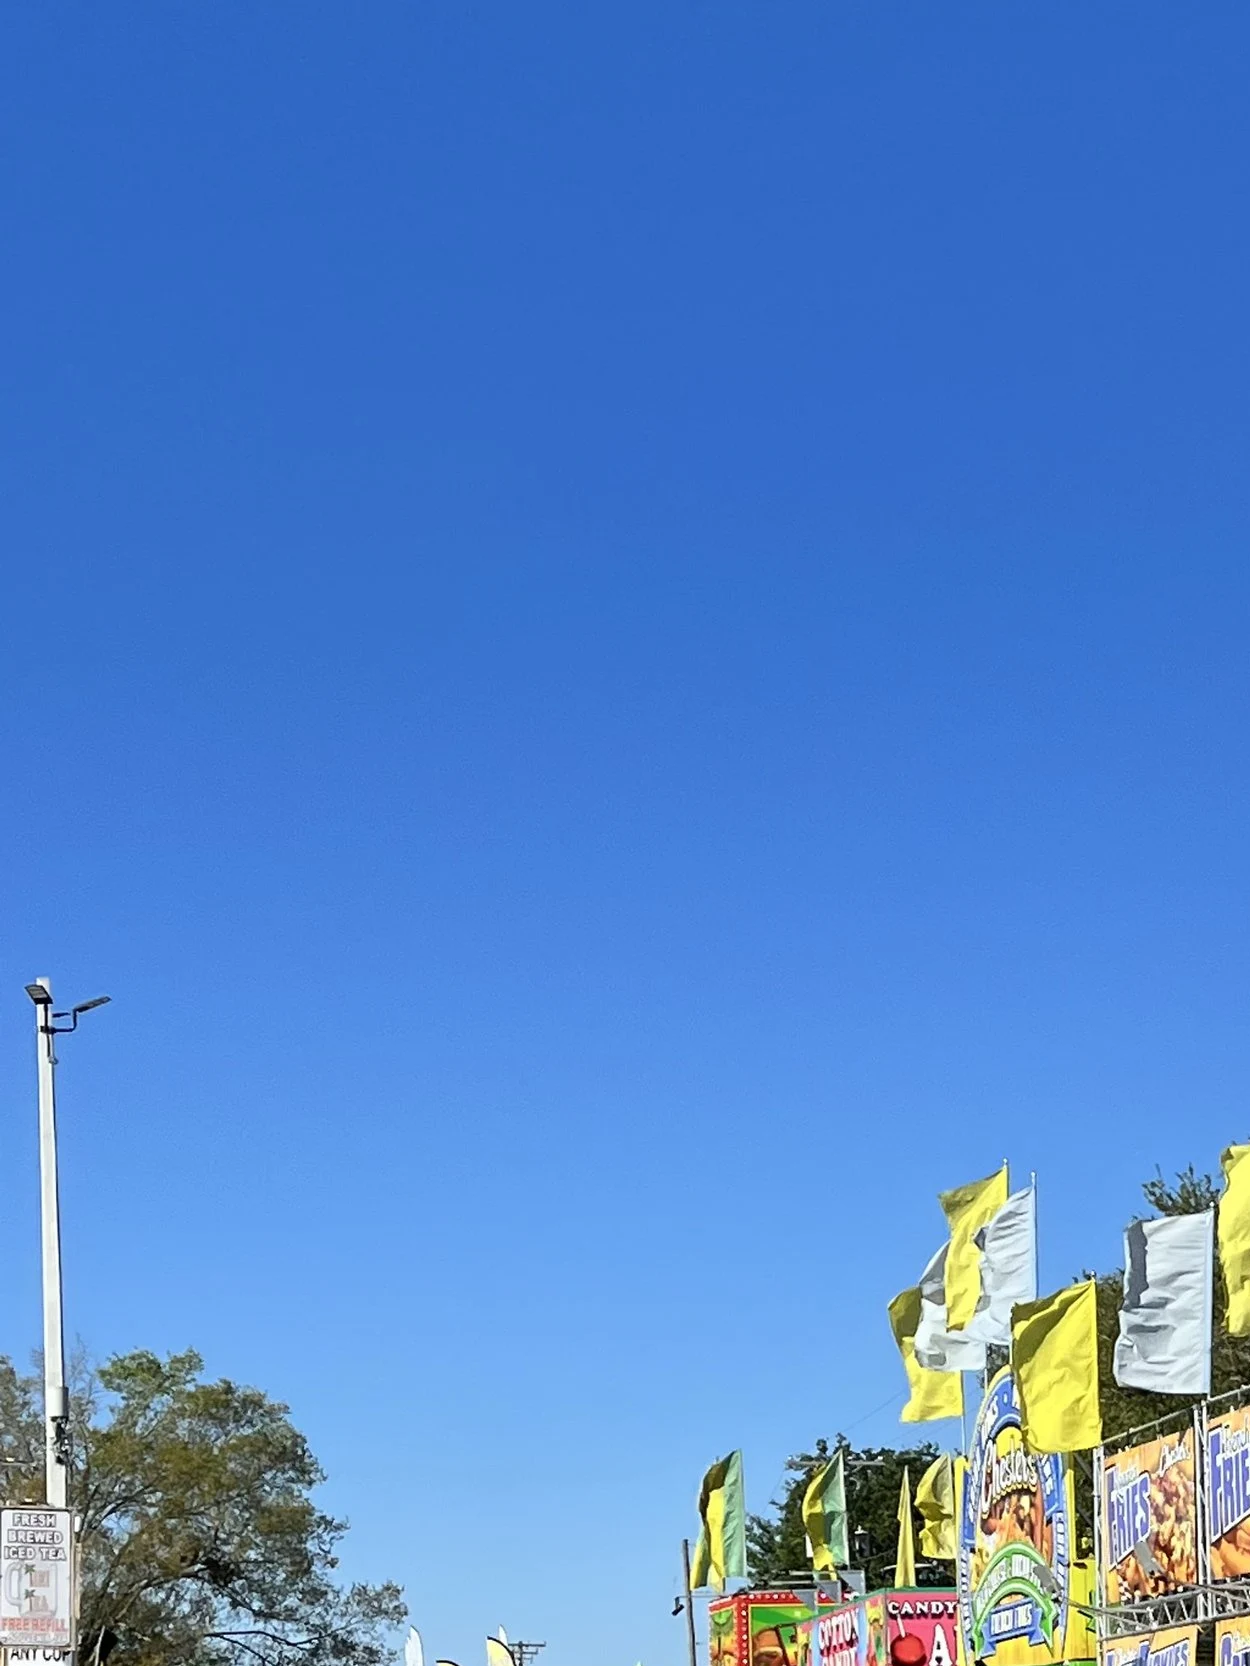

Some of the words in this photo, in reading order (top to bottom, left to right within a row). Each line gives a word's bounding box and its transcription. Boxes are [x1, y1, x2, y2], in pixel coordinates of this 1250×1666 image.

[13, 1513, 56, 1528] FRESH
[1105, 1467, 1151, 1570] FRIES
[7, 1528, 64, 1544] BREWED
[4, 1546, 36, 1560] ICED
[40, 1546, 67, 1562] TEA
[887, 1600, 957, 1619] CANDY
[2, 1617, 30, 1631] FREE
[818, 1607, 859, 1650] COTTON
[43, 1648, 71, 1661] CUP
